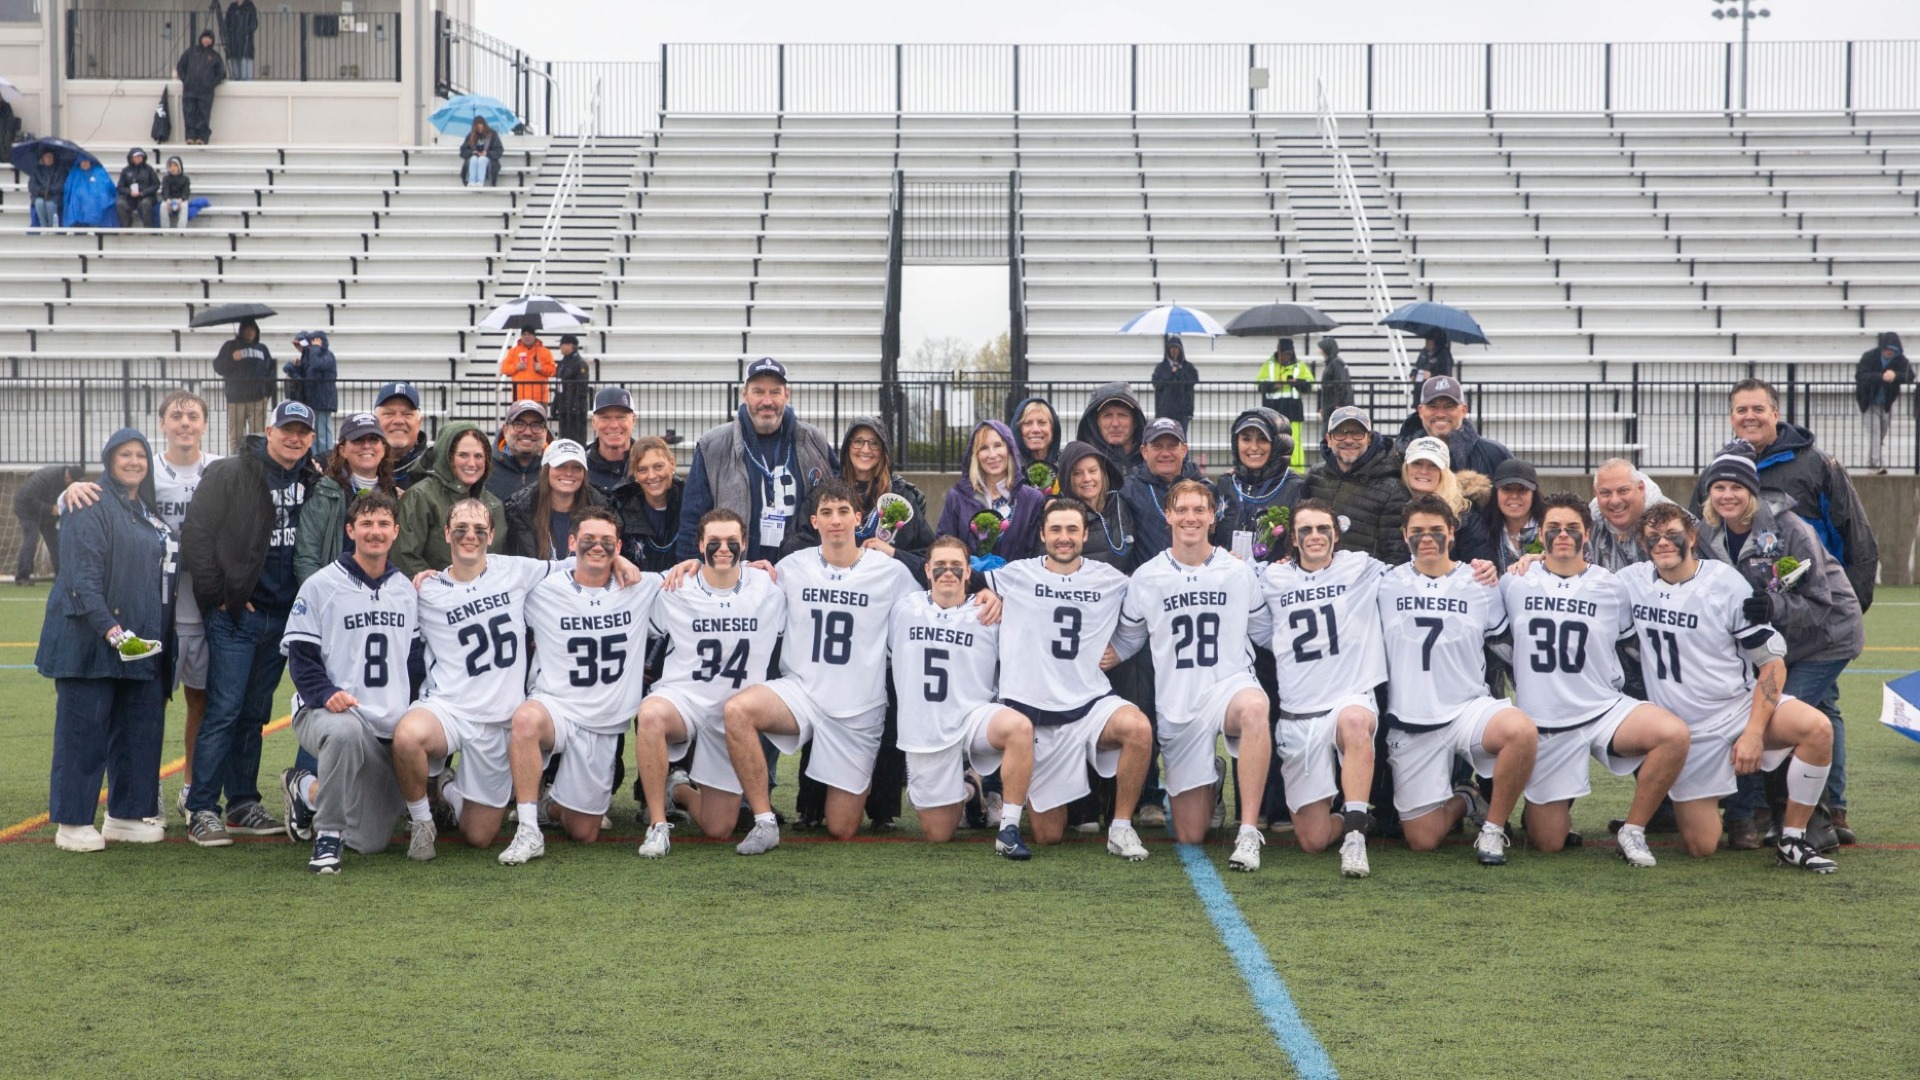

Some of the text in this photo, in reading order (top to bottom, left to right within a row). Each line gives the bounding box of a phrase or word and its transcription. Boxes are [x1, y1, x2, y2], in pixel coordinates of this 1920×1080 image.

[344, 610, 405, 631] GENESEO
[447, 592, 511, 626] GENESEO
[561, 611, 631, 631] GENESEO
[803, 589, 868, 606] GENESEO
[1164, 592, 1226, 611] GENESEO
[1280, 586, 1345, 607] GENESEO
[1397, 597, 1467, 613] GENESEO
[1525, 597, 1596, 616] GENESEO
[1633, 605, 1697, 630] GENESEO
[458, 613, 517, 677] 26
[693, 618, 757, 632] GENESEO
[811, 610, 853, 664] 18
[910, 627, 973, 647] GENESEO
[1052, 607, 1081, 660] 3
[1173, 613, 1219, 669] 28
[1290, 604, 1339, 662] 21
[1415, 618, 1443, 671] 7
[1529, 618, 1588, 673] 30
[364, 633, 388, 687] 8
[568, 633, 627, 687] 35
[692, 639, 749, 689] 34
[924, 649, 949, 702] 5
[1647, 627, 1682, 683] 11
